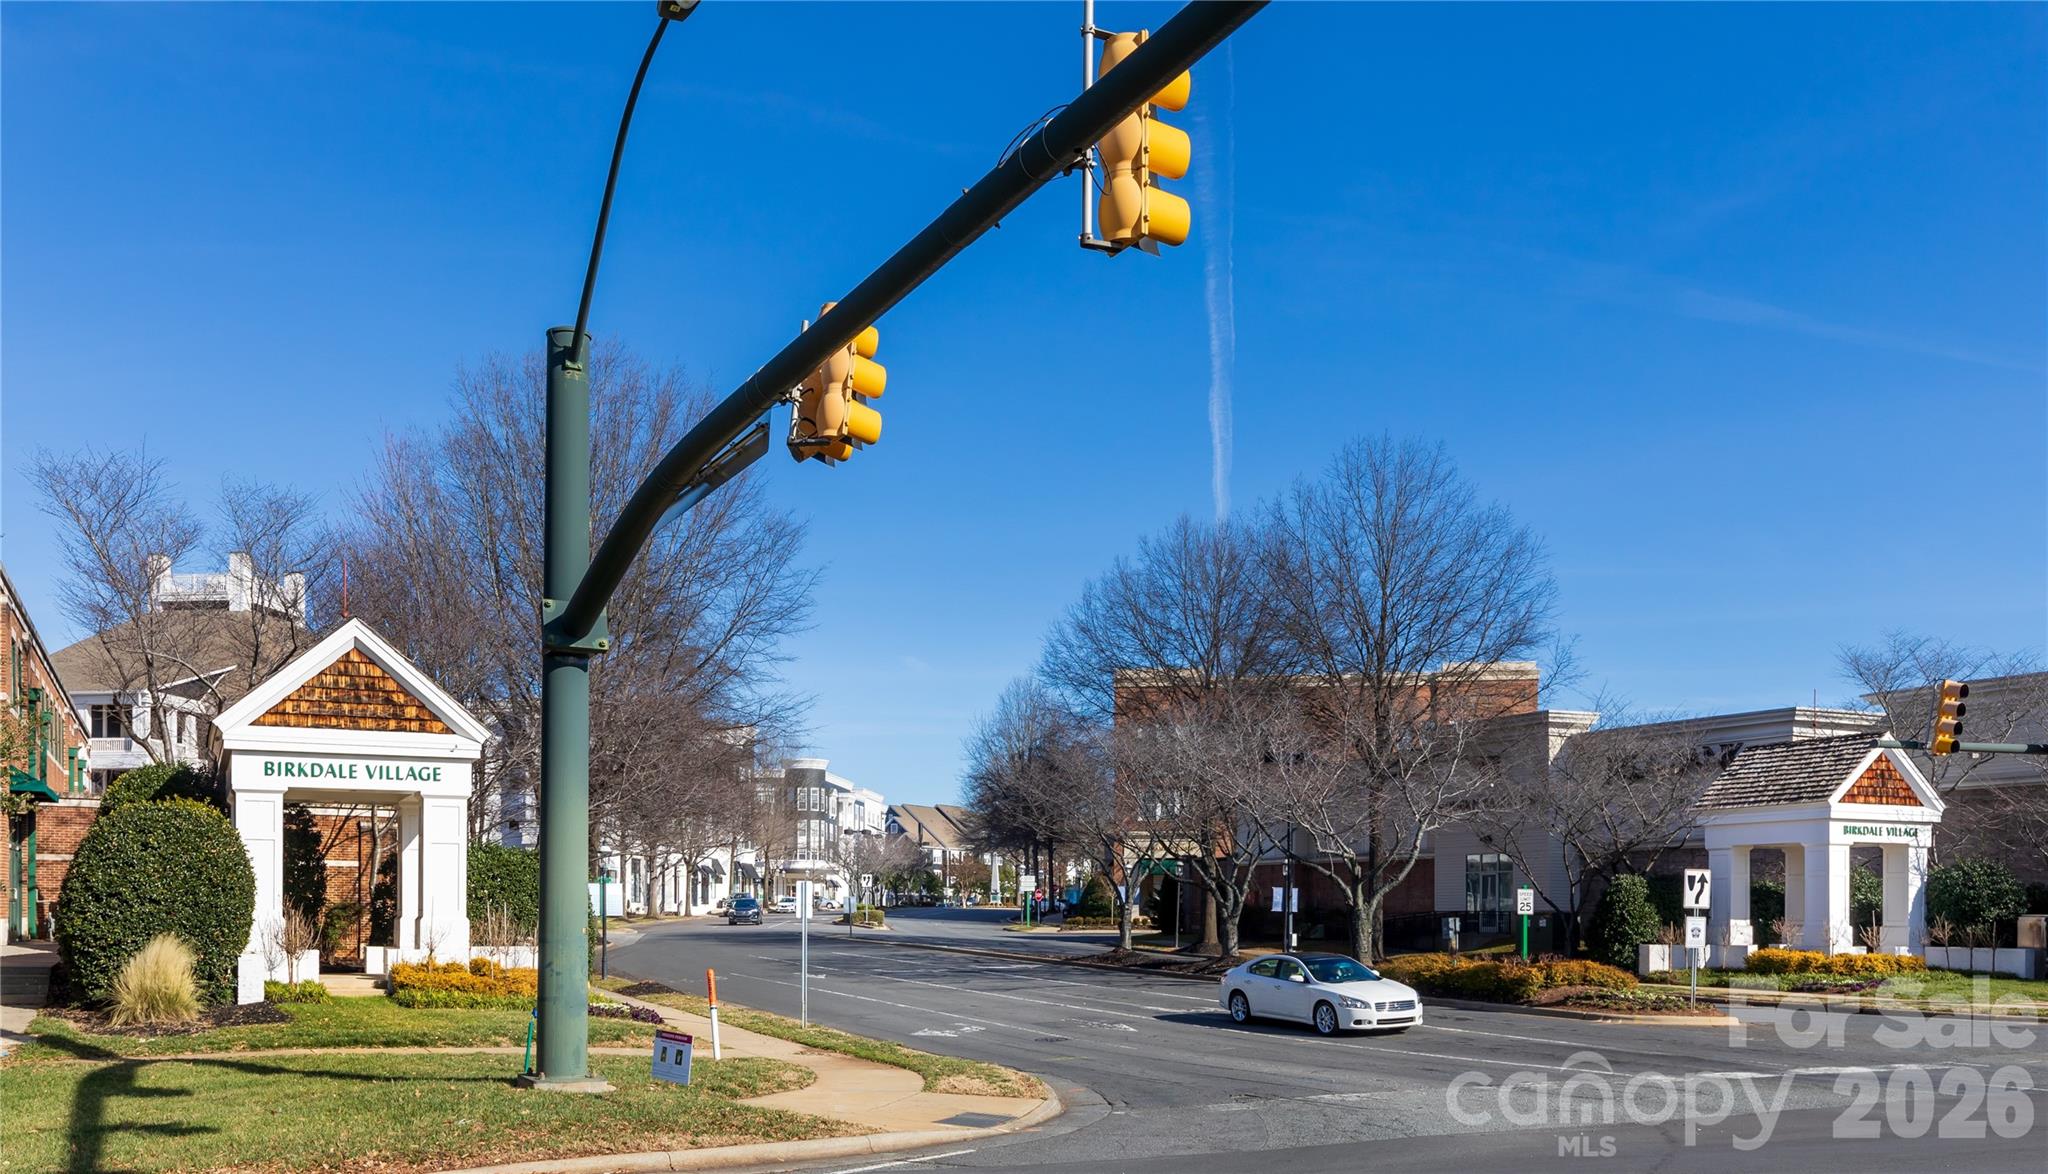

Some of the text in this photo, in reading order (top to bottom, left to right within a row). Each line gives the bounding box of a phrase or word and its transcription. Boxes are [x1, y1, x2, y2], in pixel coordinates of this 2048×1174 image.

[264, 761, 442, 782] BIRKDALE VILLAGE
[1843, 825, 1918, 837] BIRKDALE VILLAGE
[1519, 902, 1531, 911] 25
